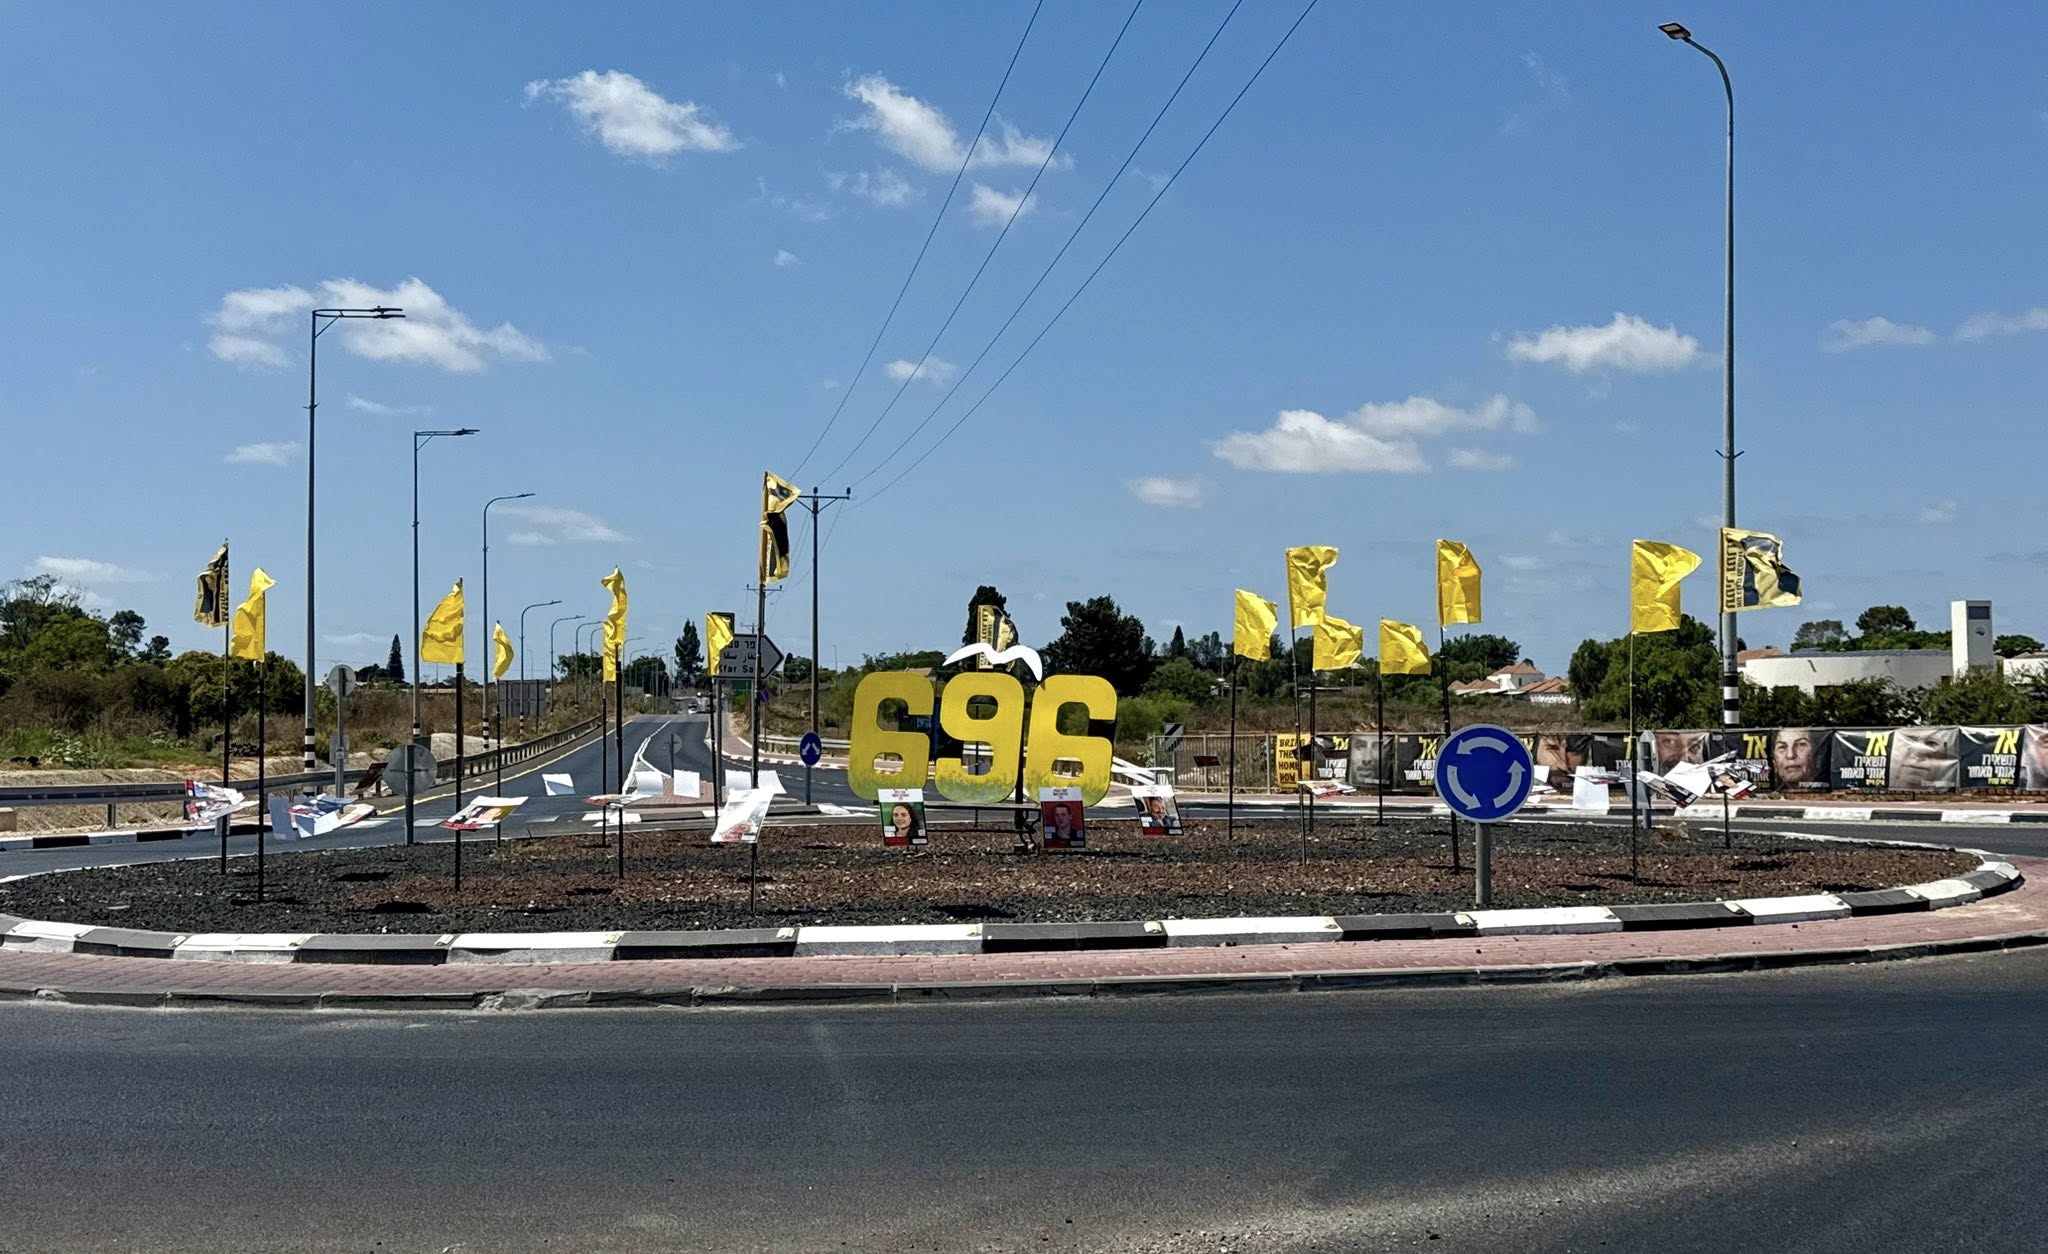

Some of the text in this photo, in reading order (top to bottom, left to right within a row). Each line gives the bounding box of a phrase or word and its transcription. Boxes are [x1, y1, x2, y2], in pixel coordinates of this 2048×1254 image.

[745, 641, 756, 649] פר
[742, 665, 764, 673] Saa
[848, 672, 1117, 807] 696
[1279, 739, 1306, 748] BRIG
[1419, 736, 1439, 760] אל
[1743, 733, 1768, 759] אל
[1865, 731, 1889, 757] אל
[1994, 728, 2020, 755] אל
[1279, 750, 1294, 758] THE
